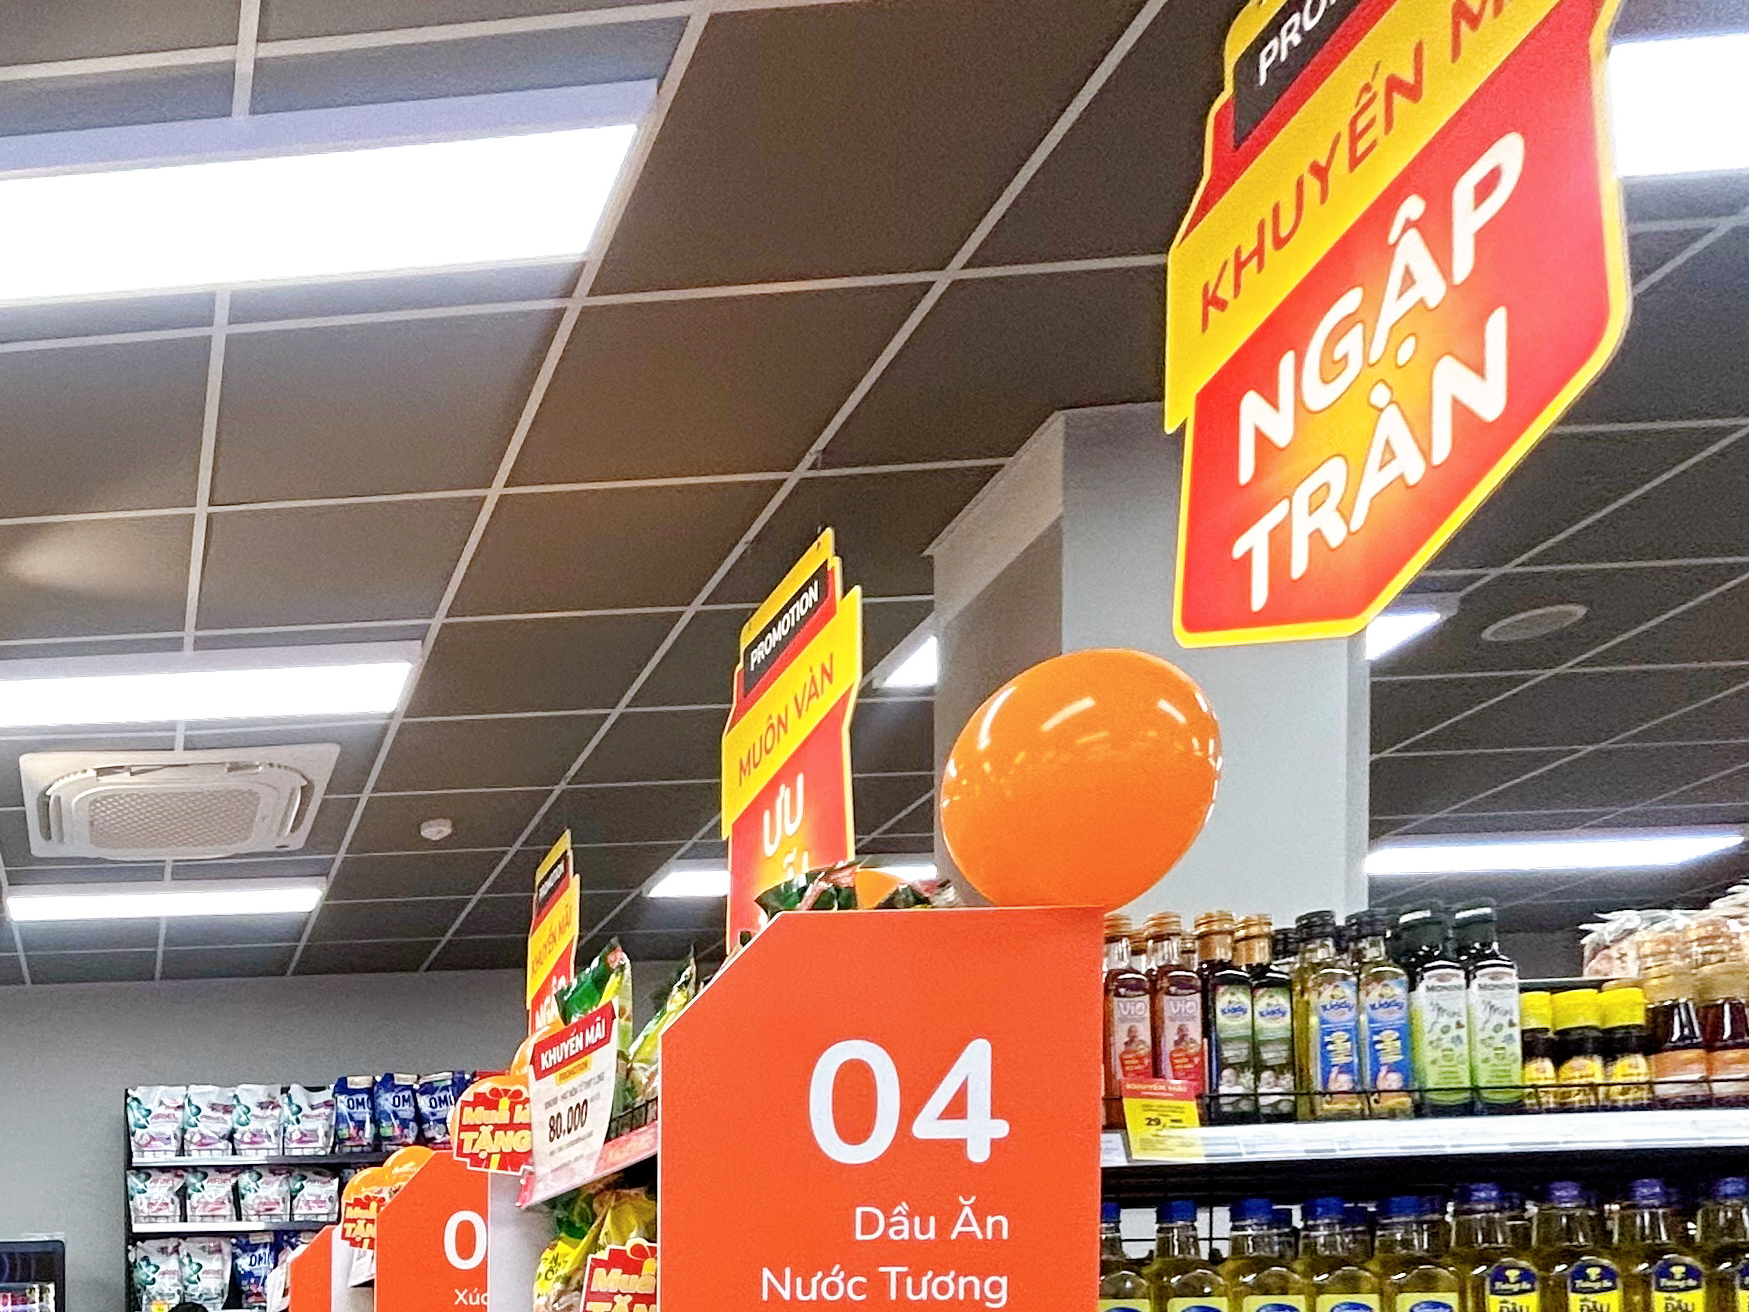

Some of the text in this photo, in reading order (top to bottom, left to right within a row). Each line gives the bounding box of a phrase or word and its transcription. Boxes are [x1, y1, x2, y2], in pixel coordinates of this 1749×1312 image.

[1200, 40, 1426, 334] KHUYẾN
[1238, 131, 1526, 486] NGẬP
[1231, 305, 1508, 614] TRÀN
[750, 580, 819, 671] PROMOTION
[739, 712, 788, 785] MUÔN
[763, 772, 804, 857] ƯU
[541, 1016, 606, 1071] KHUYẾN MÃI
[462, 1106, 510, 1125] Mua
[549, 1098, 589, 1143] 80.000
[809, 1038, 1010, 1164] 04
[344, 1219, 375, 1242] TẶN
[444, 1210, 487, 1270] 0
[854, 1194, 1010, 1241] Dầu Ăn
[591, 1268, 656, 1294] Mua
[761, 1263, 1008, 1309] Nước Tương
